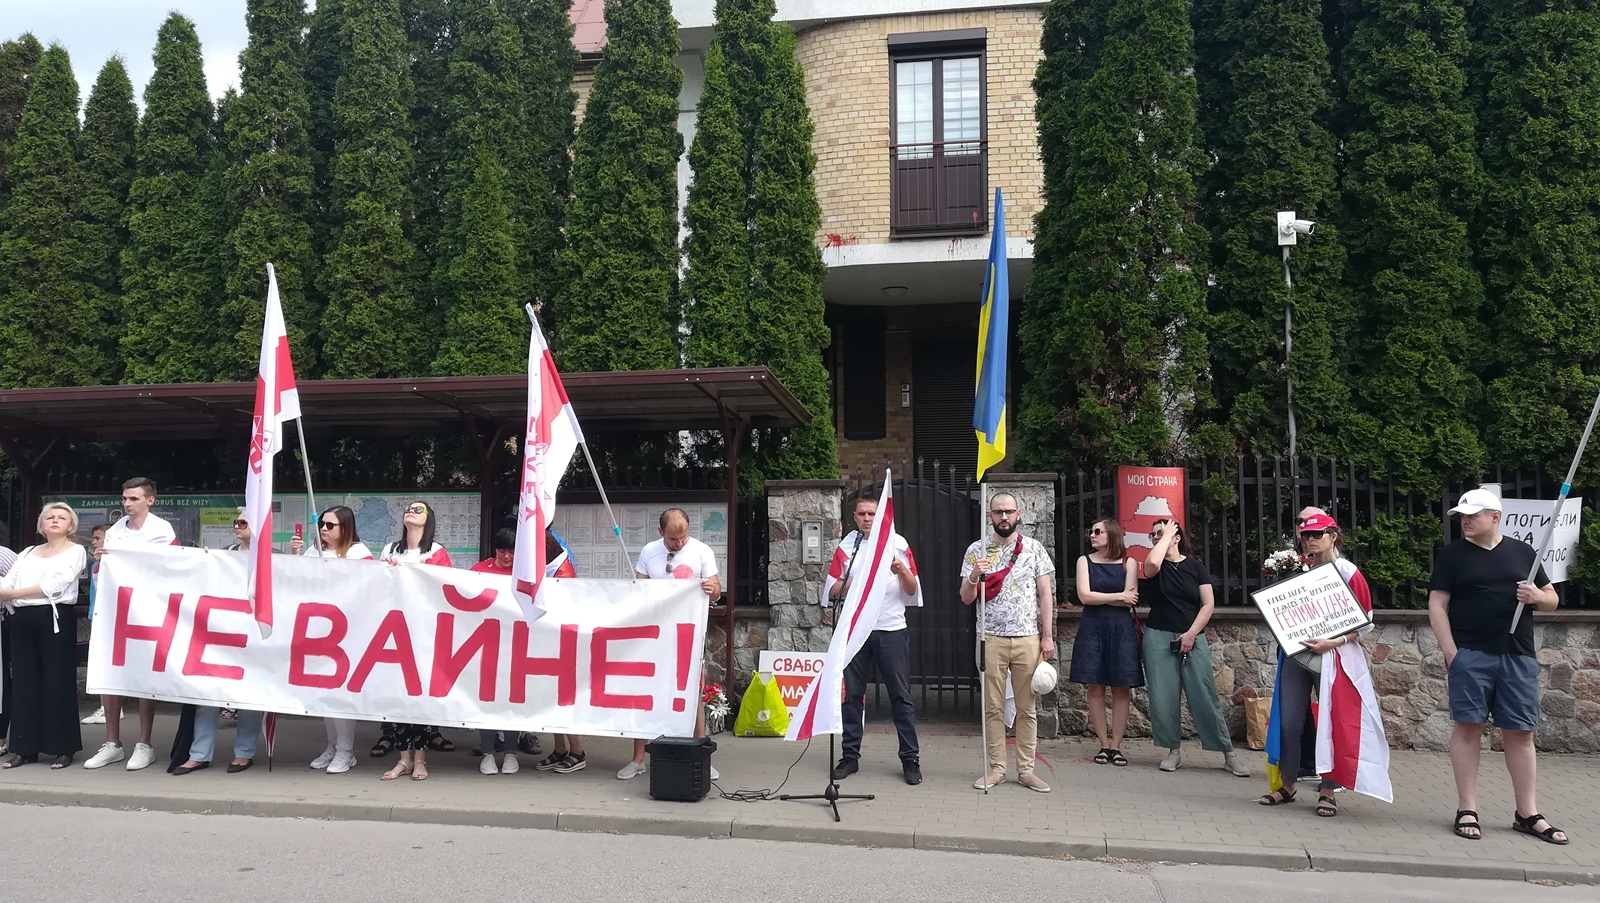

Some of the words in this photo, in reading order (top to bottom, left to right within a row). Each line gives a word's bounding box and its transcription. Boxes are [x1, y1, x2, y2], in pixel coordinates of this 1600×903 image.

[1127, 474, 1145, 485] МОЯ
[1146, 475, 1178, 487] СТРАНА
[153, 498, 174, 506] ORUŚ
[1512, 531, 1534, 545] ЗА
[1536, 547, 1567, 562] ЛОС
[112, 586, 253, 681] НЕ
[288, 584, 696, 713] ВАЙНЕ!
[773, 658, 825, 673] СВАБО
[781, 683, 811, 699] МА
